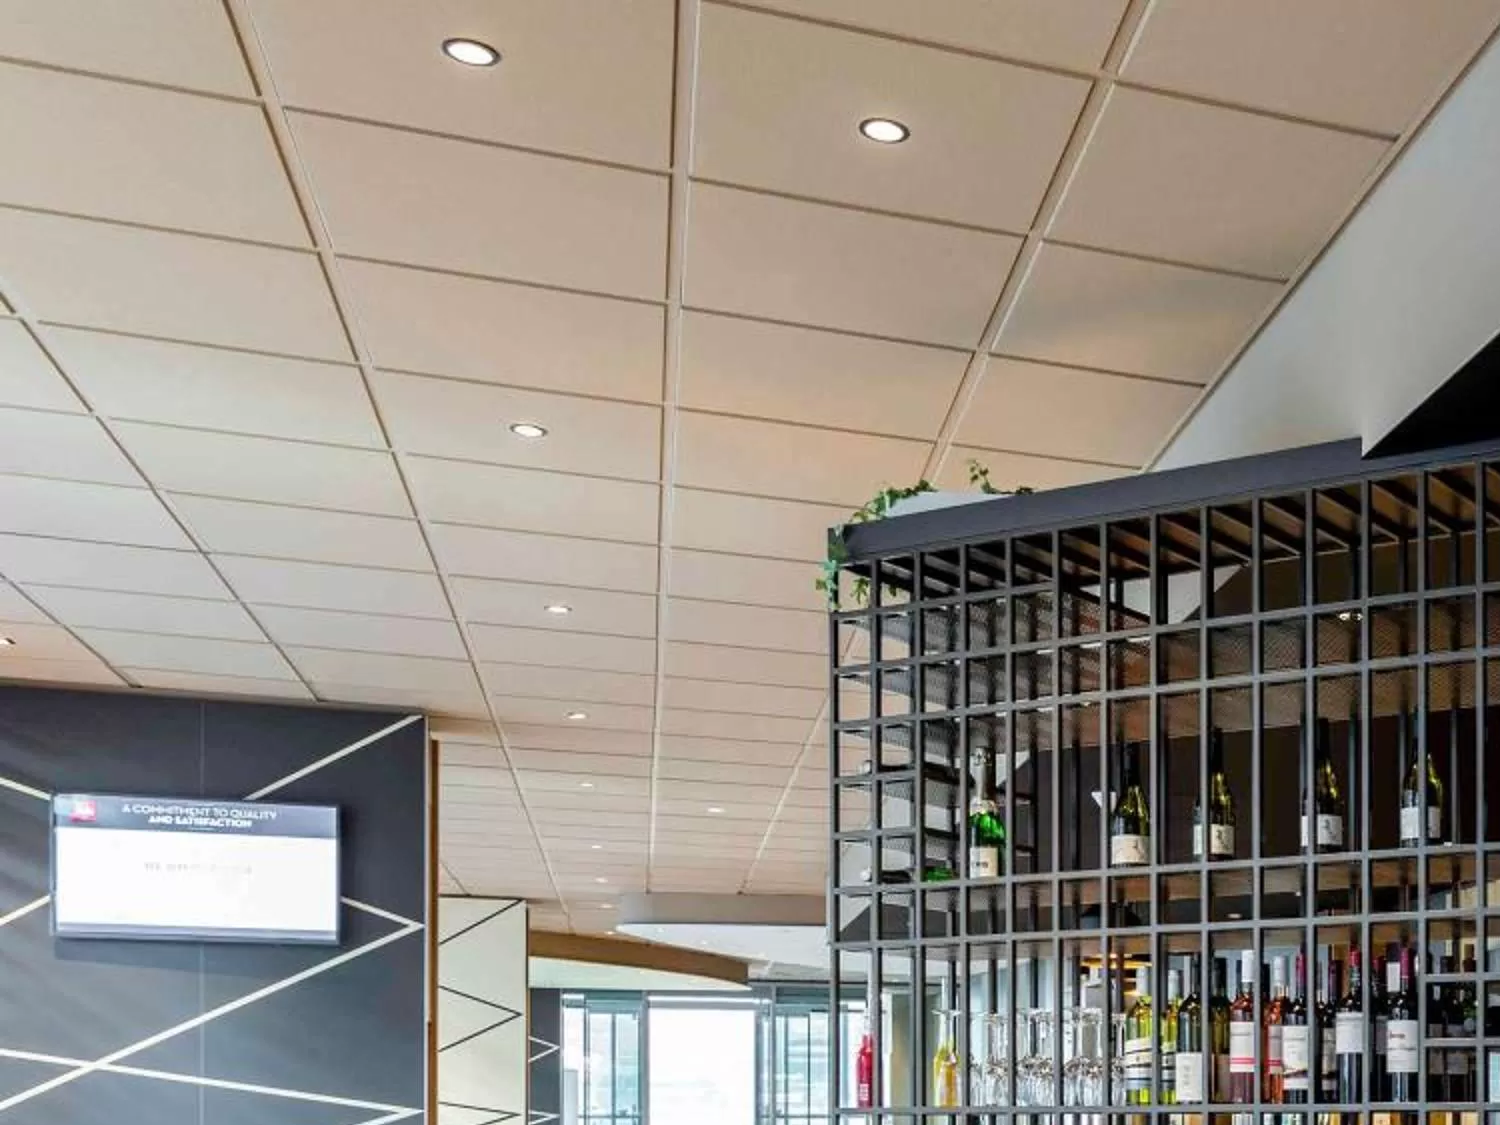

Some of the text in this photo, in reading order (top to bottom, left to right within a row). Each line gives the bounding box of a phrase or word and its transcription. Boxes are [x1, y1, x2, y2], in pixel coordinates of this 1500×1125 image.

[121, 804, 131, 813] A
[213, 807, 228, 816] TO
[230, 808, 277, 819] QUALITY
[148, 815, 252, 828] AND SATISFACTION
